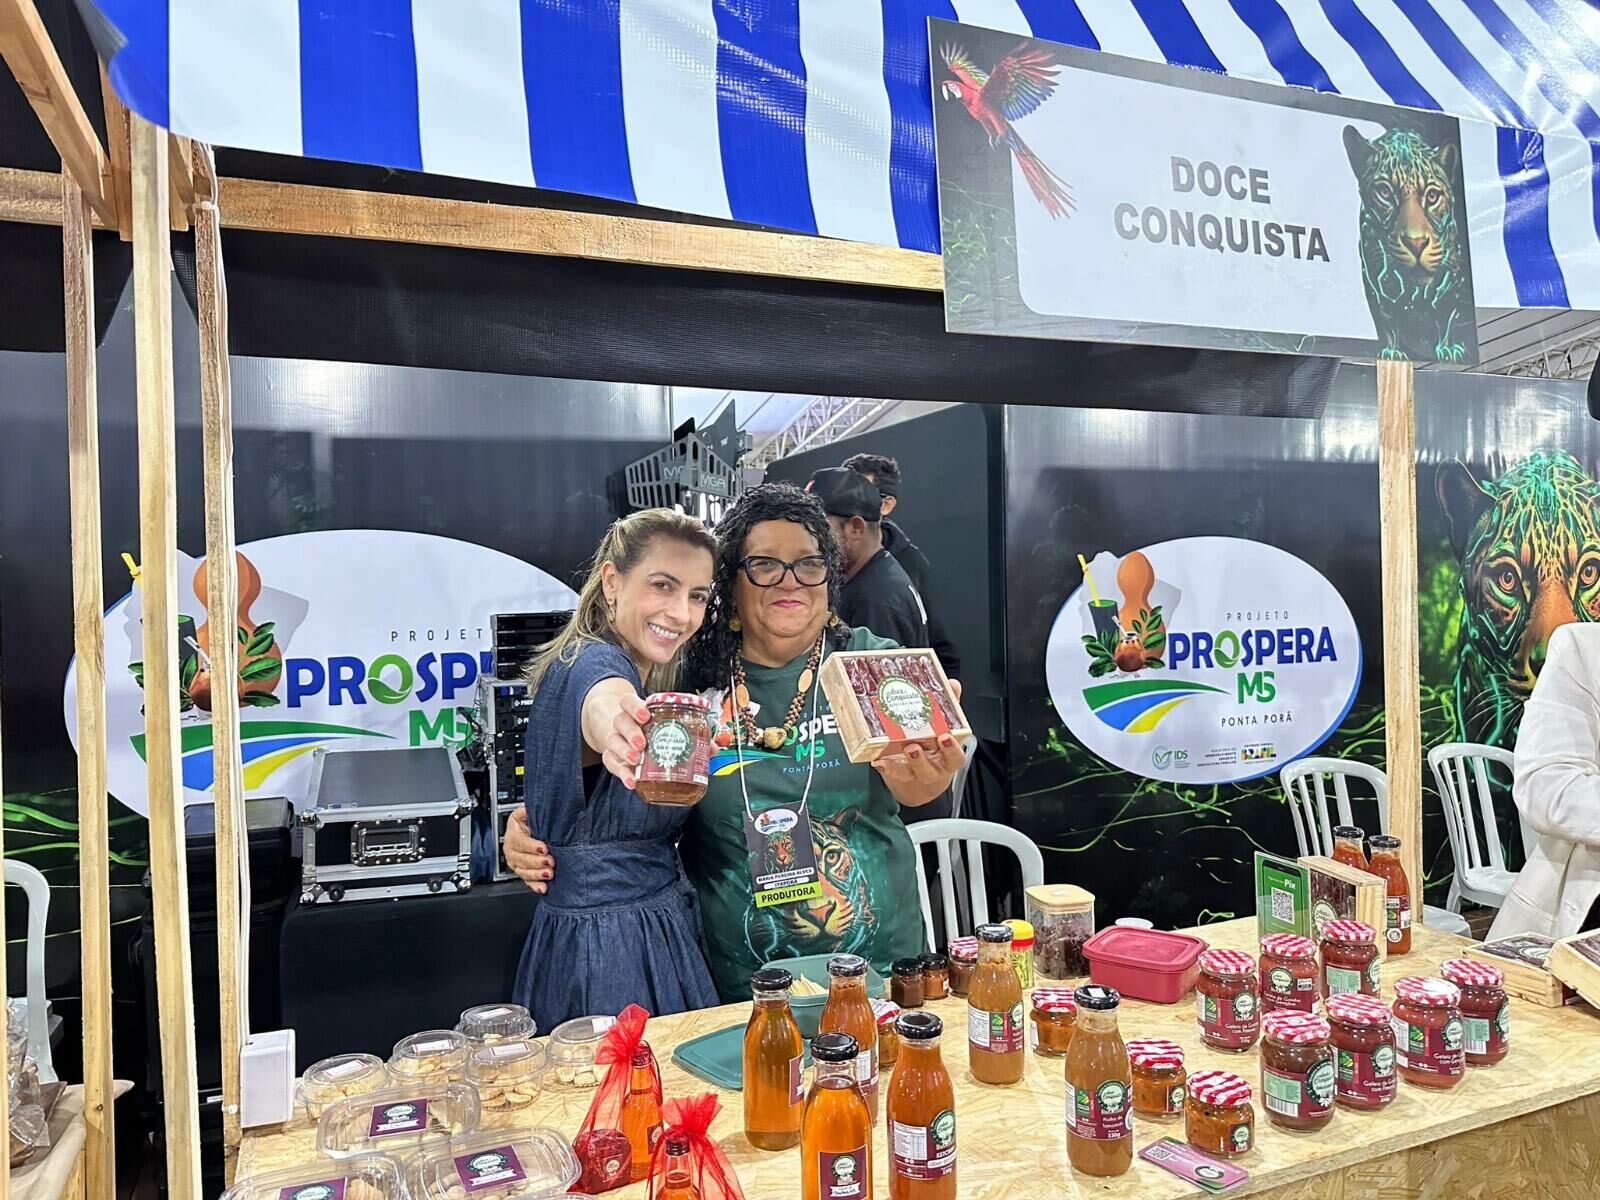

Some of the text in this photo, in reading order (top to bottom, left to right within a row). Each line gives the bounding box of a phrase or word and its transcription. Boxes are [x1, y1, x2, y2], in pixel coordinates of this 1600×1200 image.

[1170, 155, 1272, 204] DOCE
[1113, 202, 1331, 263] CONQUISTA
[700, 473, 726, 489] MGA
[1226, 610, 1289, 622] PROJETO
[1168, 626, 1338, 671] PROSPERA
[1237, 670, 1276, 705] MS
[1221, 711, 1293, 727] PONTA PORÃ
[795, 739, 826, 762] MS
[1174, 750, 1188, 760] IDS
[1284, 878, 1297, 890] Pix
[761, 886, 816, 904] PRODUTORA
